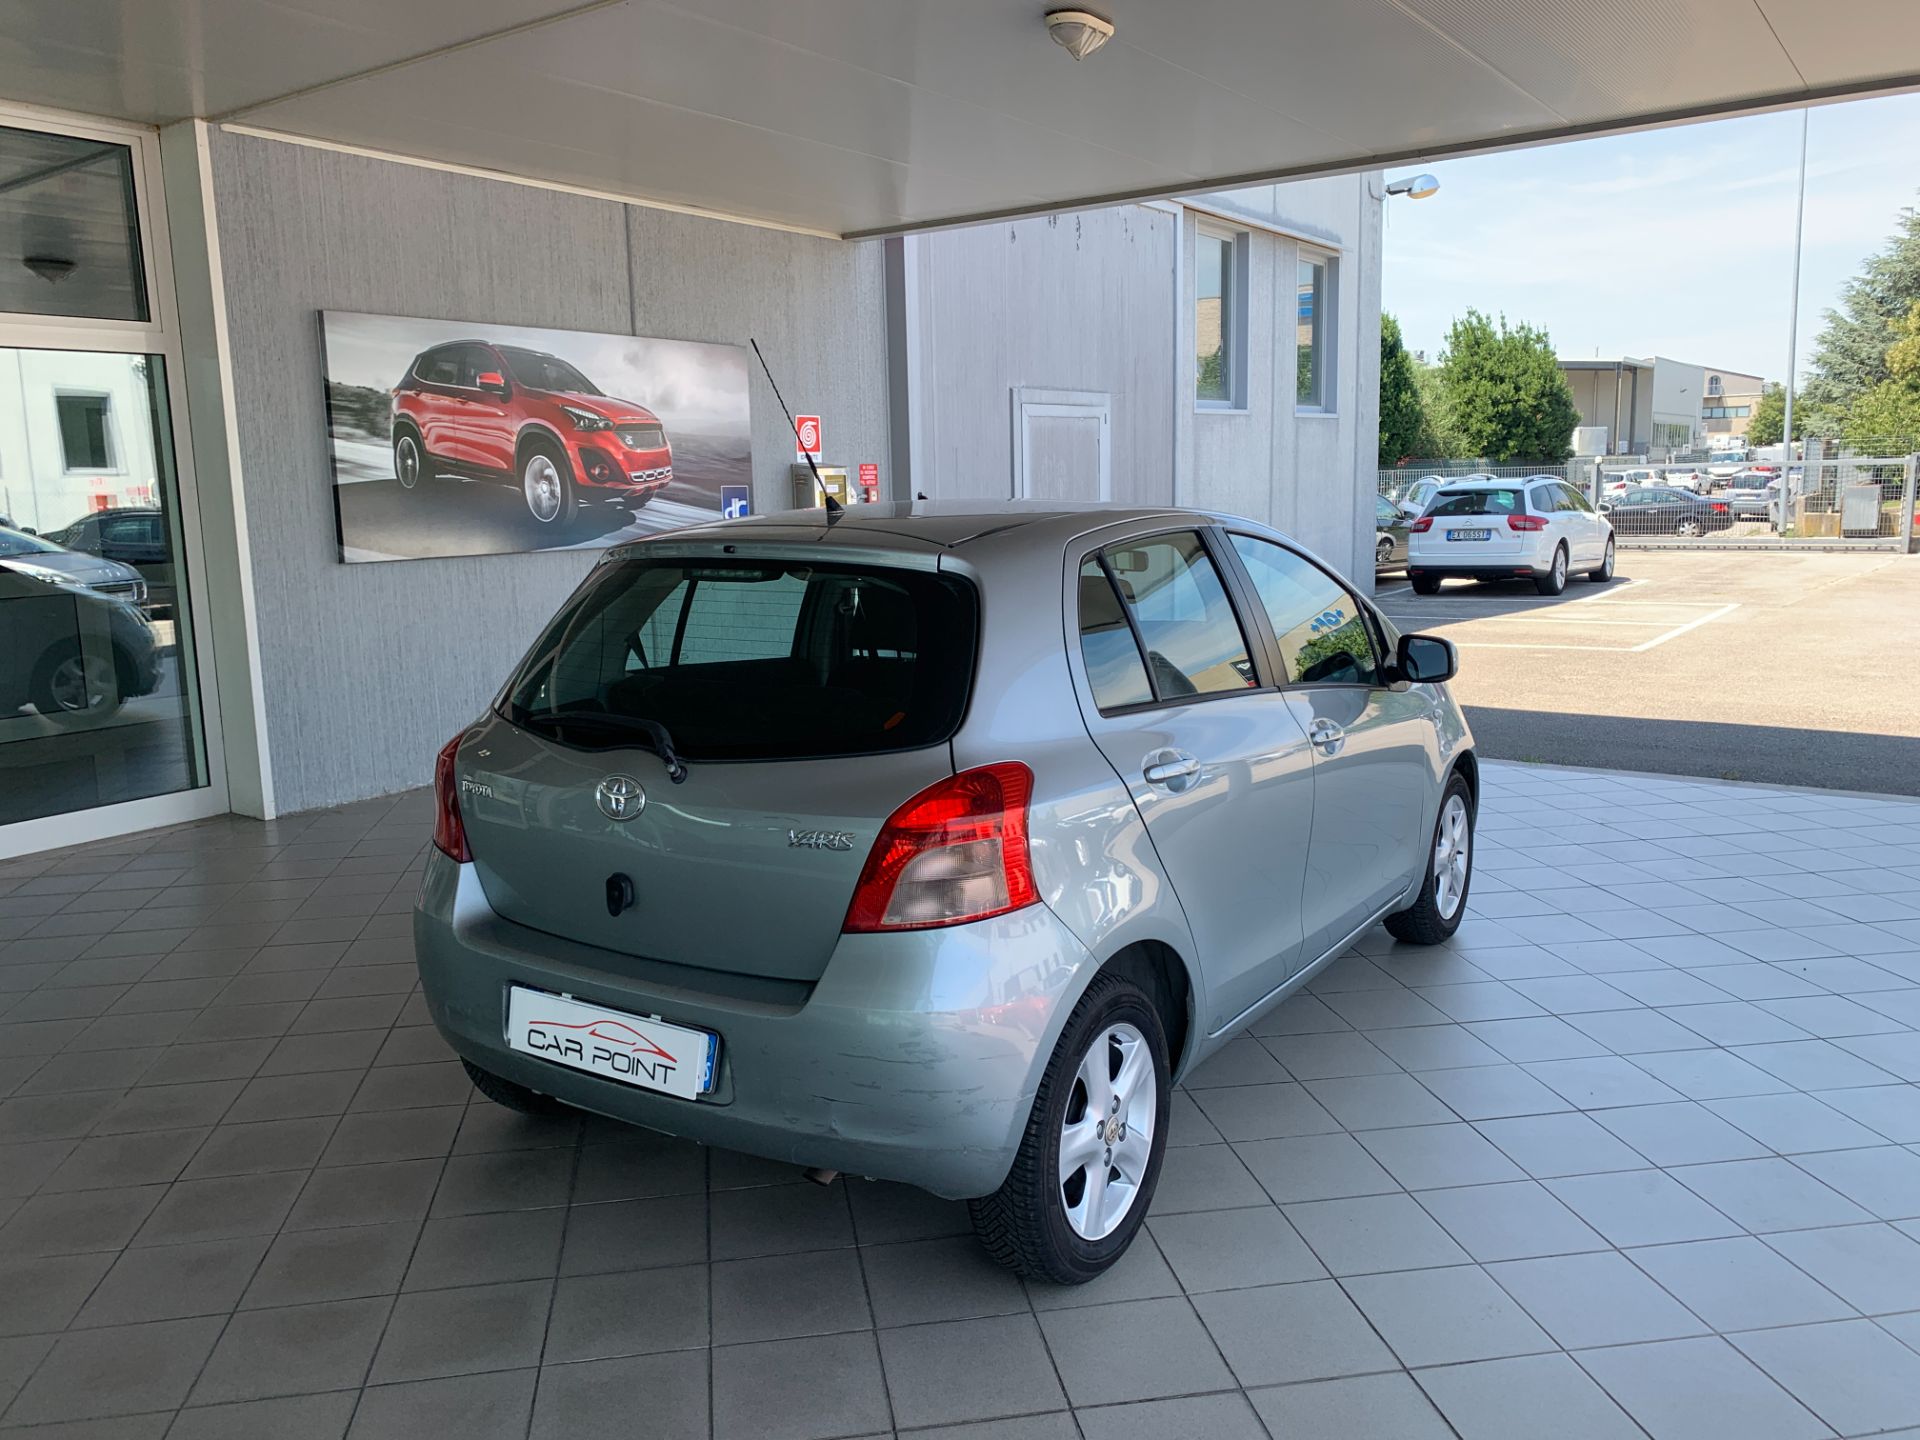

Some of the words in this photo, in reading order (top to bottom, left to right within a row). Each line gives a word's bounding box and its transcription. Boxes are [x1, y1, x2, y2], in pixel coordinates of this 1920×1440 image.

[725, 498, 747, 519] dr
[462, 781, 493, 798] TOYOTA
[527, 1029, 583, 1061] CAR
[592, 1046, 676, 1084] POINT
